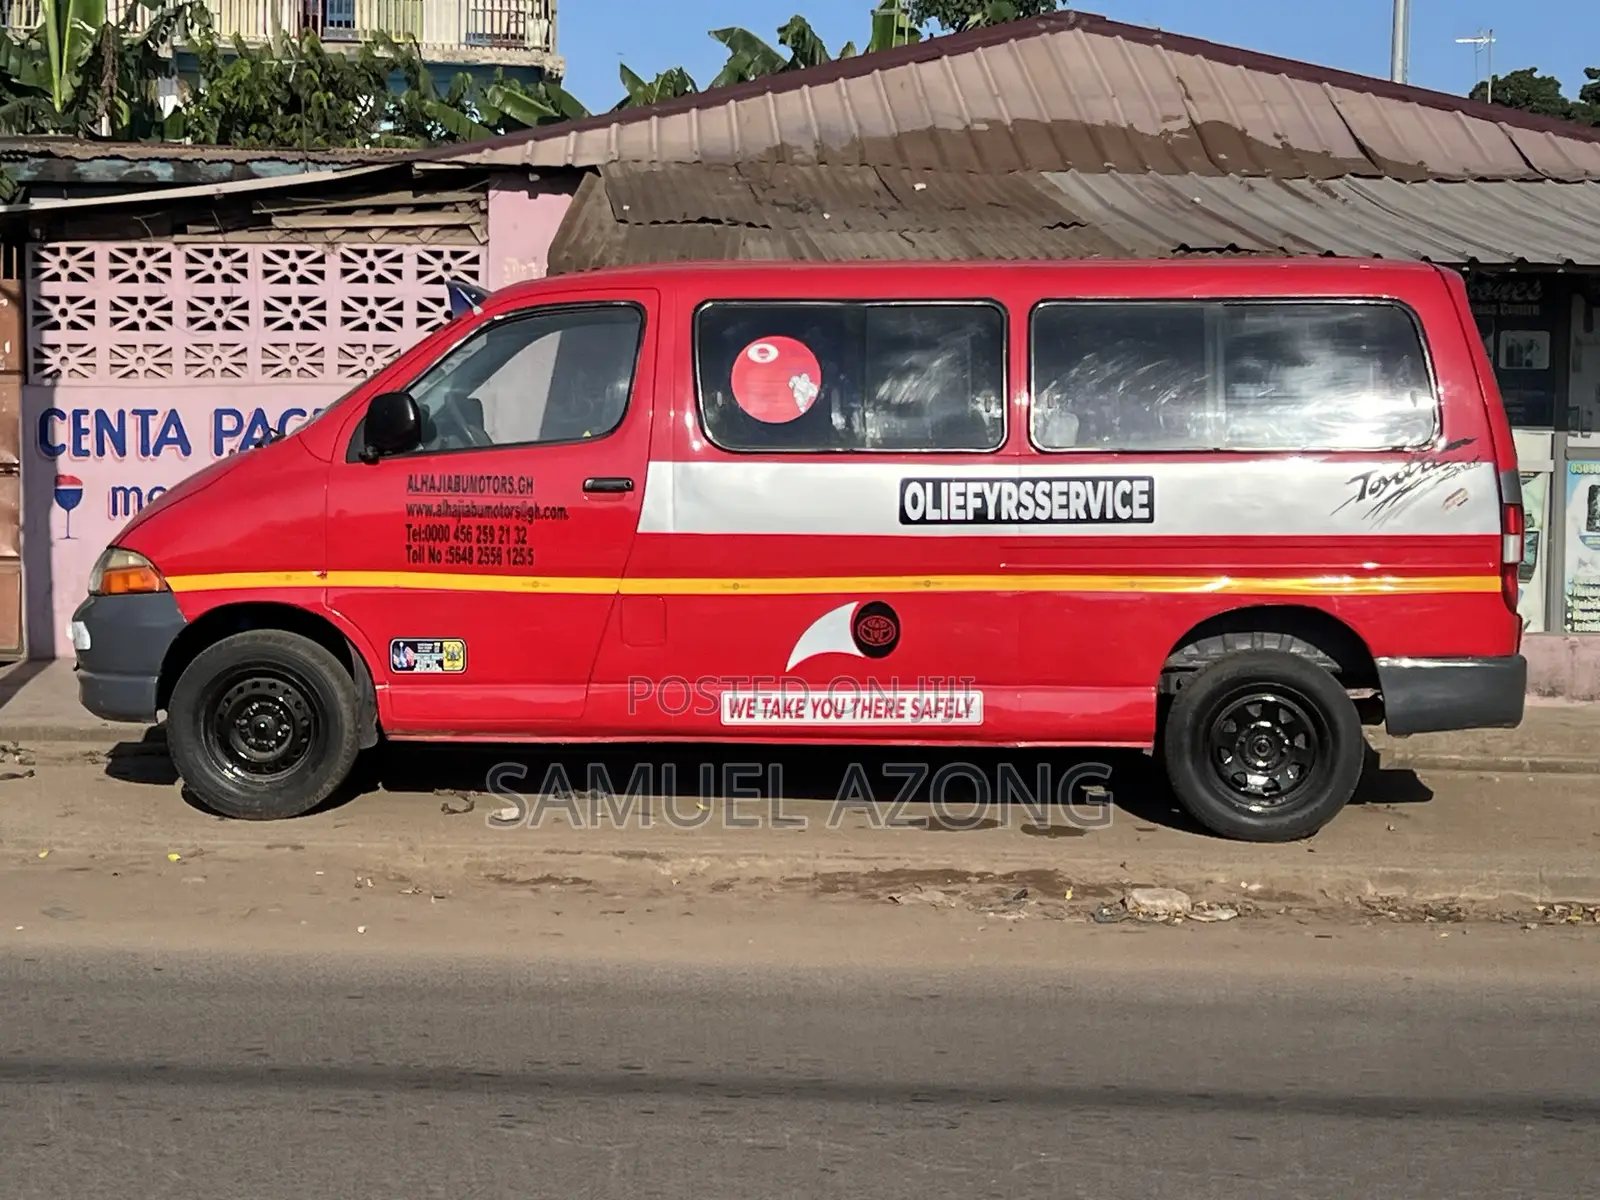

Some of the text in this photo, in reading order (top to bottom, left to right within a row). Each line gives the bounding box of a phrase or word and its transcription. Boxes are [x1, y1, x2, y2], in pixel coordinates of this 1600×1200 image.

[38, 407, 192, 458] CENTA
[904, 480, 1150, 521] OLIEFYRSSERVICE
[406, 524, 528, 545] Tel:0000 456 259 21 32
[406, 545, 425, 564] Toll
[428, 545, 442, 565] No
[728, 697, 975, 719] WE TAKE YOU THERE SAFELY
